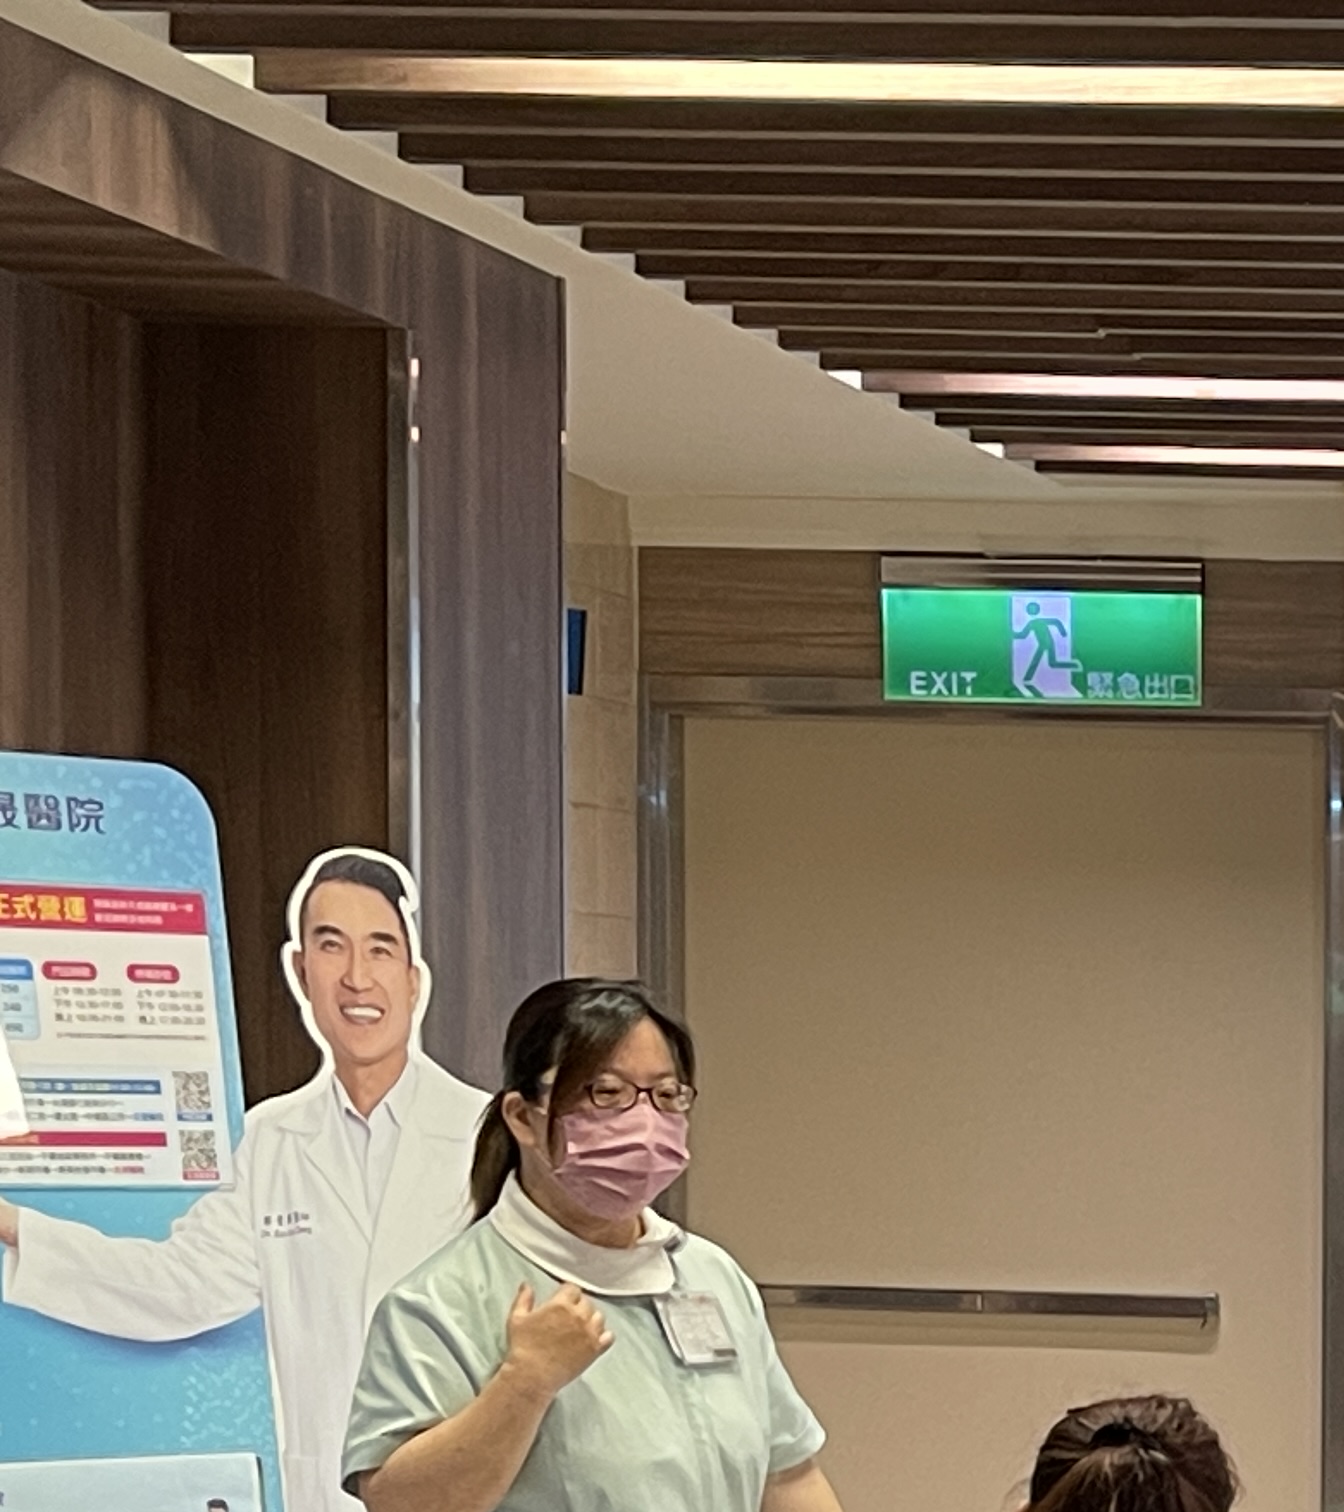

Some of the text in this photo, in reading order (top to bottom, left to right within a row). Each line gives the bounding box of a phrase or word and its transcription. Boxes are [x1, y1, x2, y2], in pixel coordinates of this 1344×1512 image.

[910, 670, 978, 697] EXIT
[1087, 672, 1195, 700] 緊急出口
